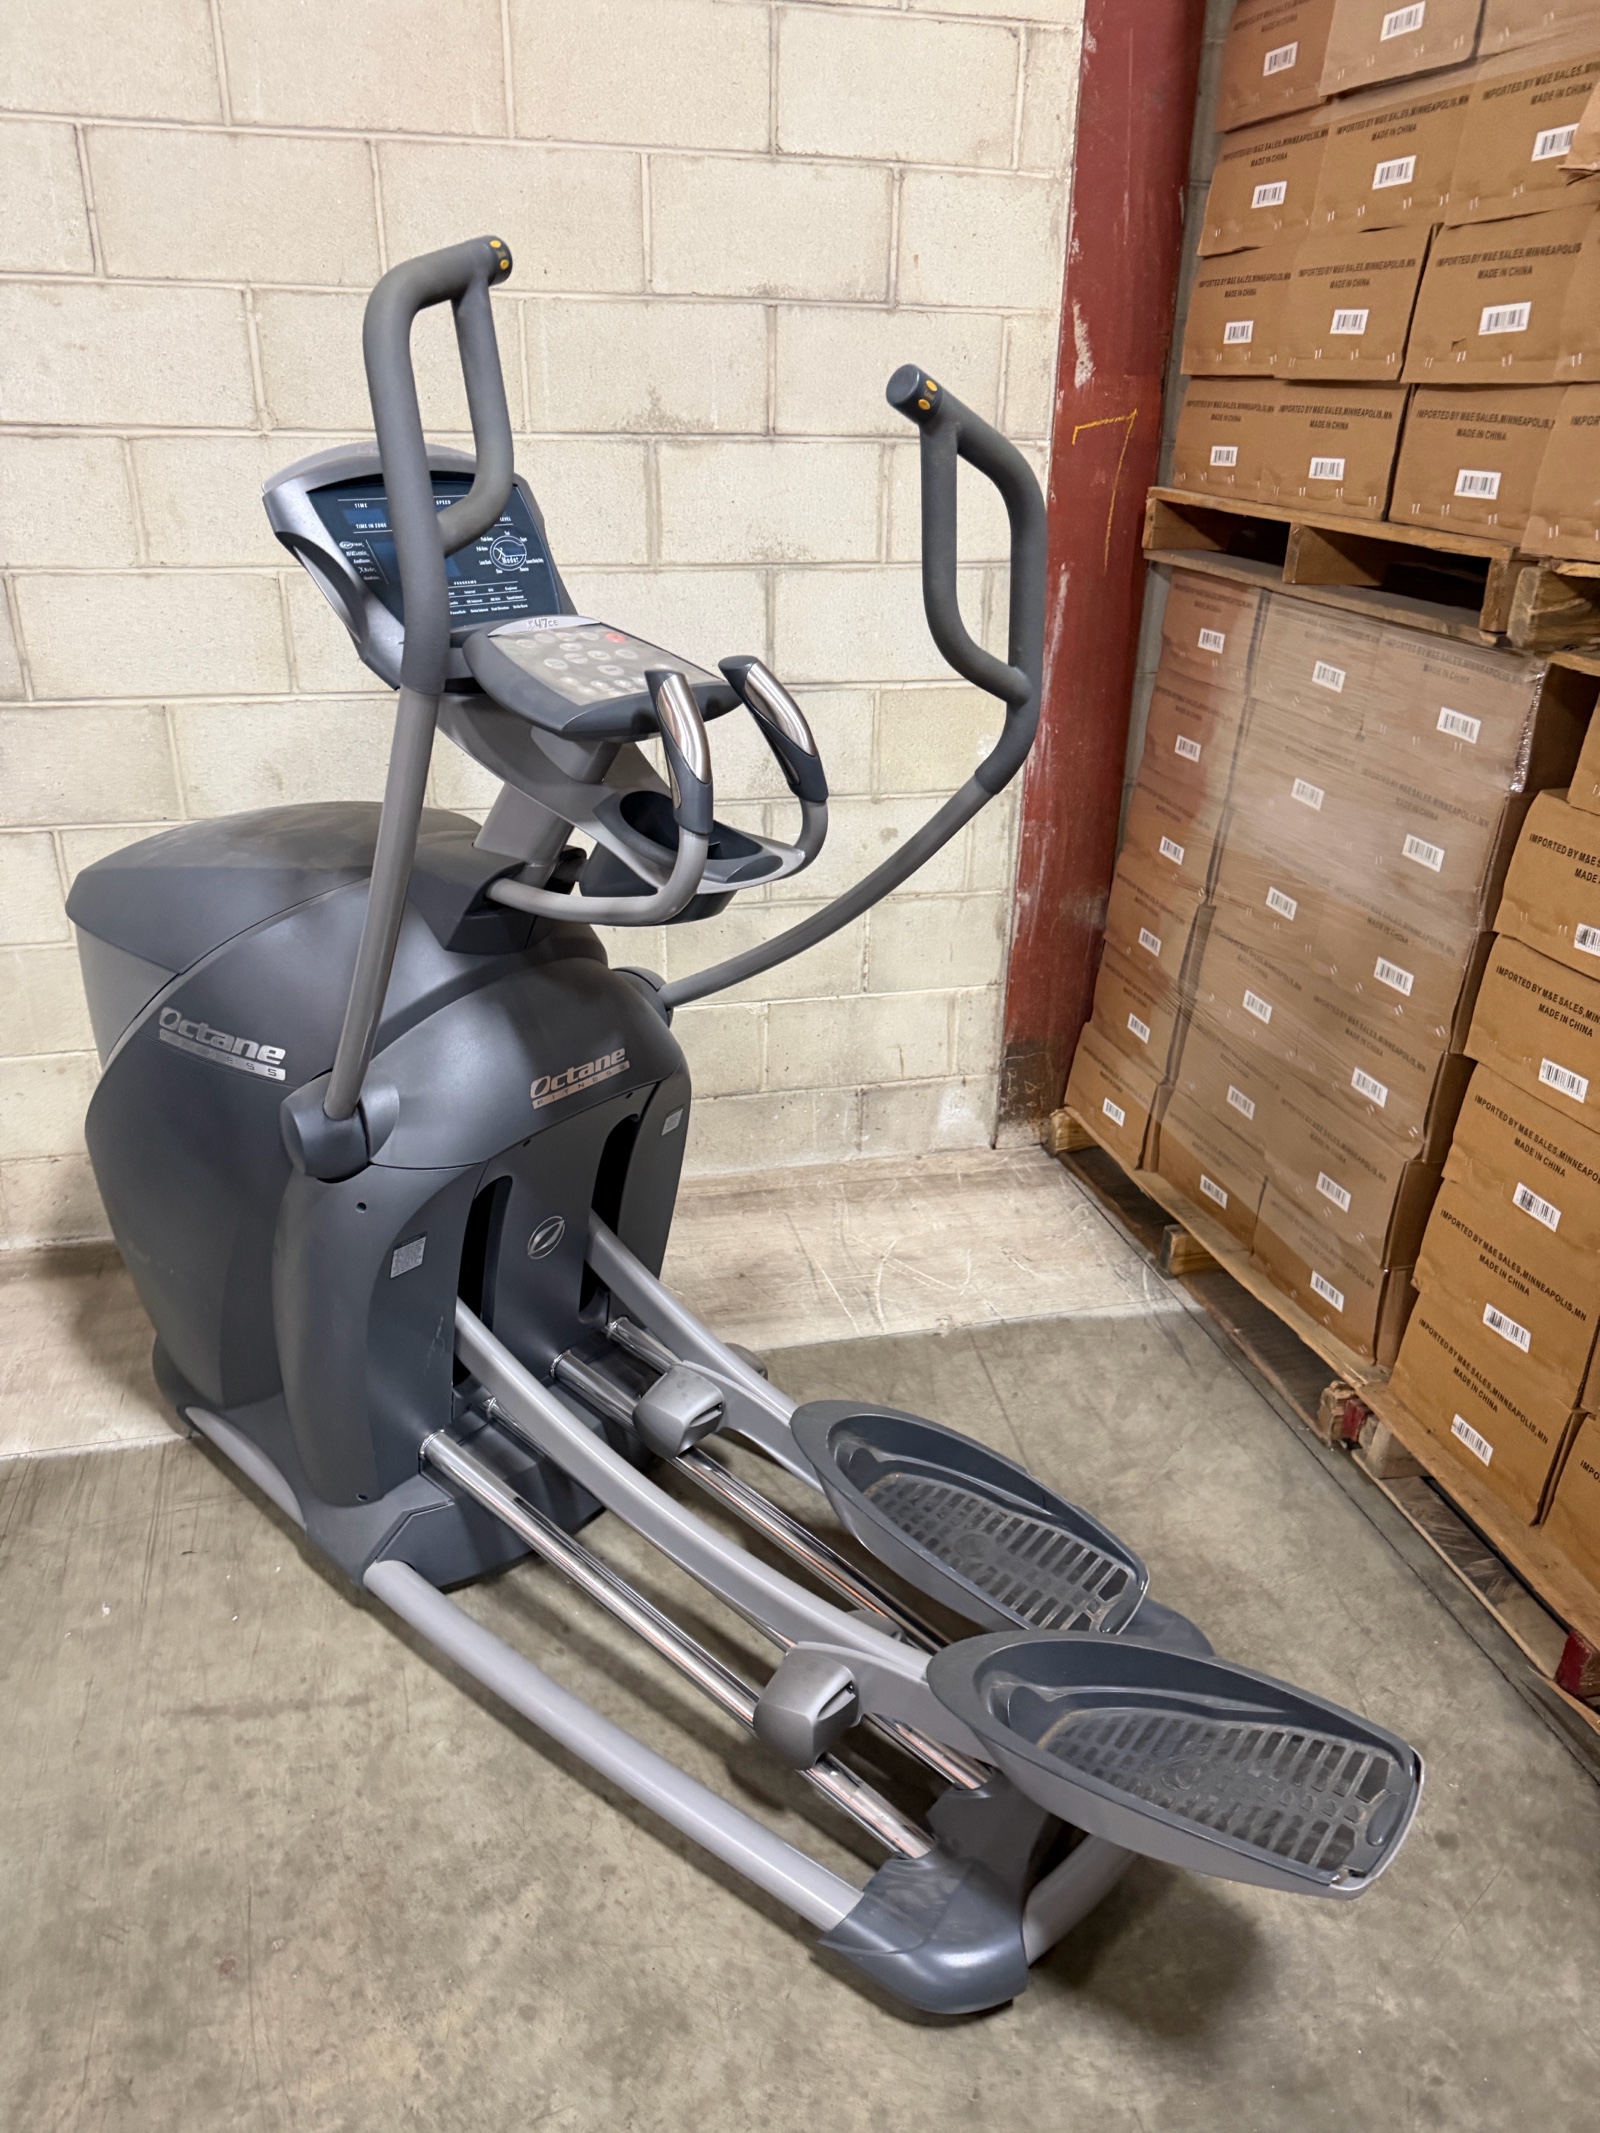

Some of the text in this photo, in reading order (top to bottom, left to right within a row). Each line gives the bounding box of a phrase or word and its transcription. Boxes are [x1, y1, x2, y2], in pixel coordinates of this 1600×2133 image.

[1436, 255, 1470, 267] IMPORTED
[1470, 254, 1482, 263] BY
[1482, 252, 1499, 262] M&E
[1477, 265, 1532, 279] MADE IN CHINA
[1416, 410, 1449, 420] IMPORTED
[1450, 411, 1460, 420] BY
[1460, 411, 1475, 422] M&E
[1456, 428, 1506, 440] MADE IN CHINA
[1529, 833, 1567, 854] IMPORTED
[1567, 848, 1578, 859] BY
[1579, 853, 1596, 865] M&E
[1575, 868, 1598, 883] MADE
[1496, 965, 1600, 1024] IMPORTED BY M&E SALES,MIN
[159, 1007, 286, 1065] Octane
[1538, 1004, 1593, 1037] MADE IN CHINA
[530, 1048, 626, 1098] Octane
[537, 1064, 626, 1106] FITNESS
[1474, 1095, 1508, 1122] IMPORTED
[1508, 1117, 1518, 1129] BY
[1518, 1124, 1533, 1139] M&E
[1514, 1138, 1566, 1177] MADE IN CHINA
[1440, 1209, 1473, 1238] IMPORTED
[1472, 1234, 1483, 1245] BY
[1483, 1241, 1498, 1257] M&E
[1479, 1254, 1530, 1296] MADE IN CHINA
[1419, 1318, 1449, 1349] IMPORTED
[1448, 1346, 1458, 1357] BY
[1458, 1354, 1471, 1370] M&E
[1453, 1366, 1498, 1413] MADE IN CHINA
[1581, 1459, 1600, 1482] IMPO
